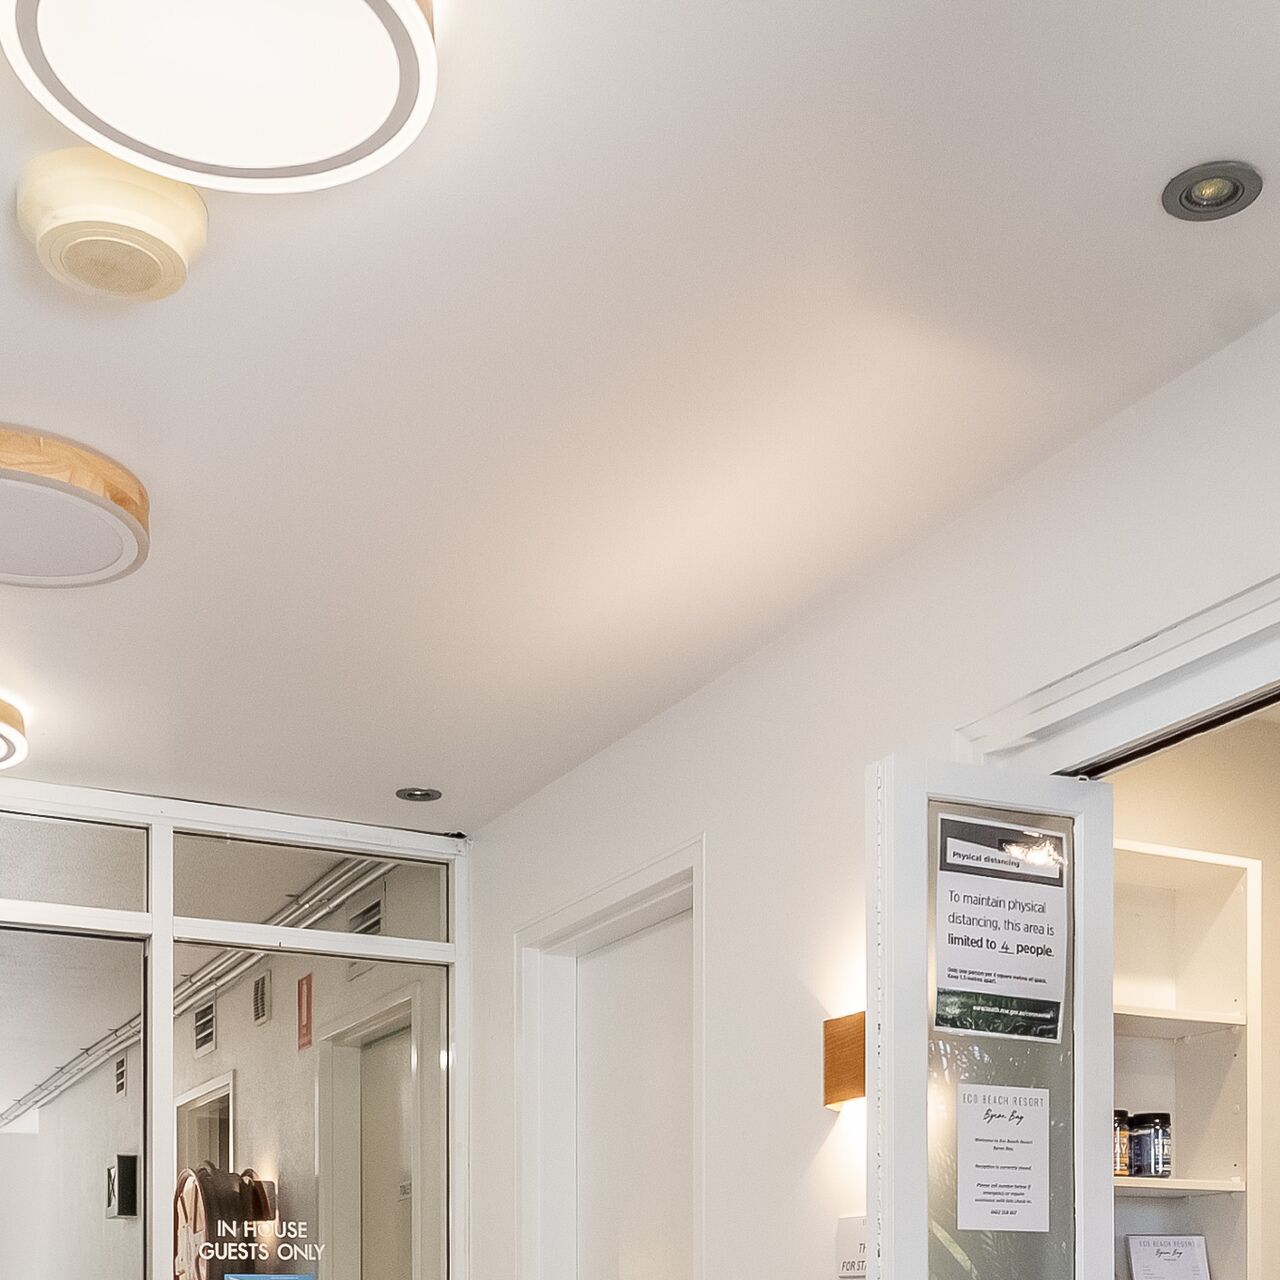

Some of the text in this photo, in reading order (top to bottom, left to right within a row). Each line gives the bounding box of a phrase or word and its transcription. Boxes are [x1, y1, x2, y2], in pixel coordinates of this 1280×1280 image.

[983, 855, 1020, 868] distancing
[948, 890, 1046, 914] To maintain physical
[948, 912, 1054, 936] distancing, this area is
[948, 933, 983, 949] limited
[986, 937, 997, 950] to
[1016, 941, 1054, 957] people.
[962, 1093, 1044, 1108] ECO BEACH RESORT
[982, 1108, 1024, 1126] Byron Bay
[217, 1220, 307, 1238] IN HOUSE
[198, 1242, 326, 1261] GUESTS ONLY
[841, 1261, 856, 1271] FOR
